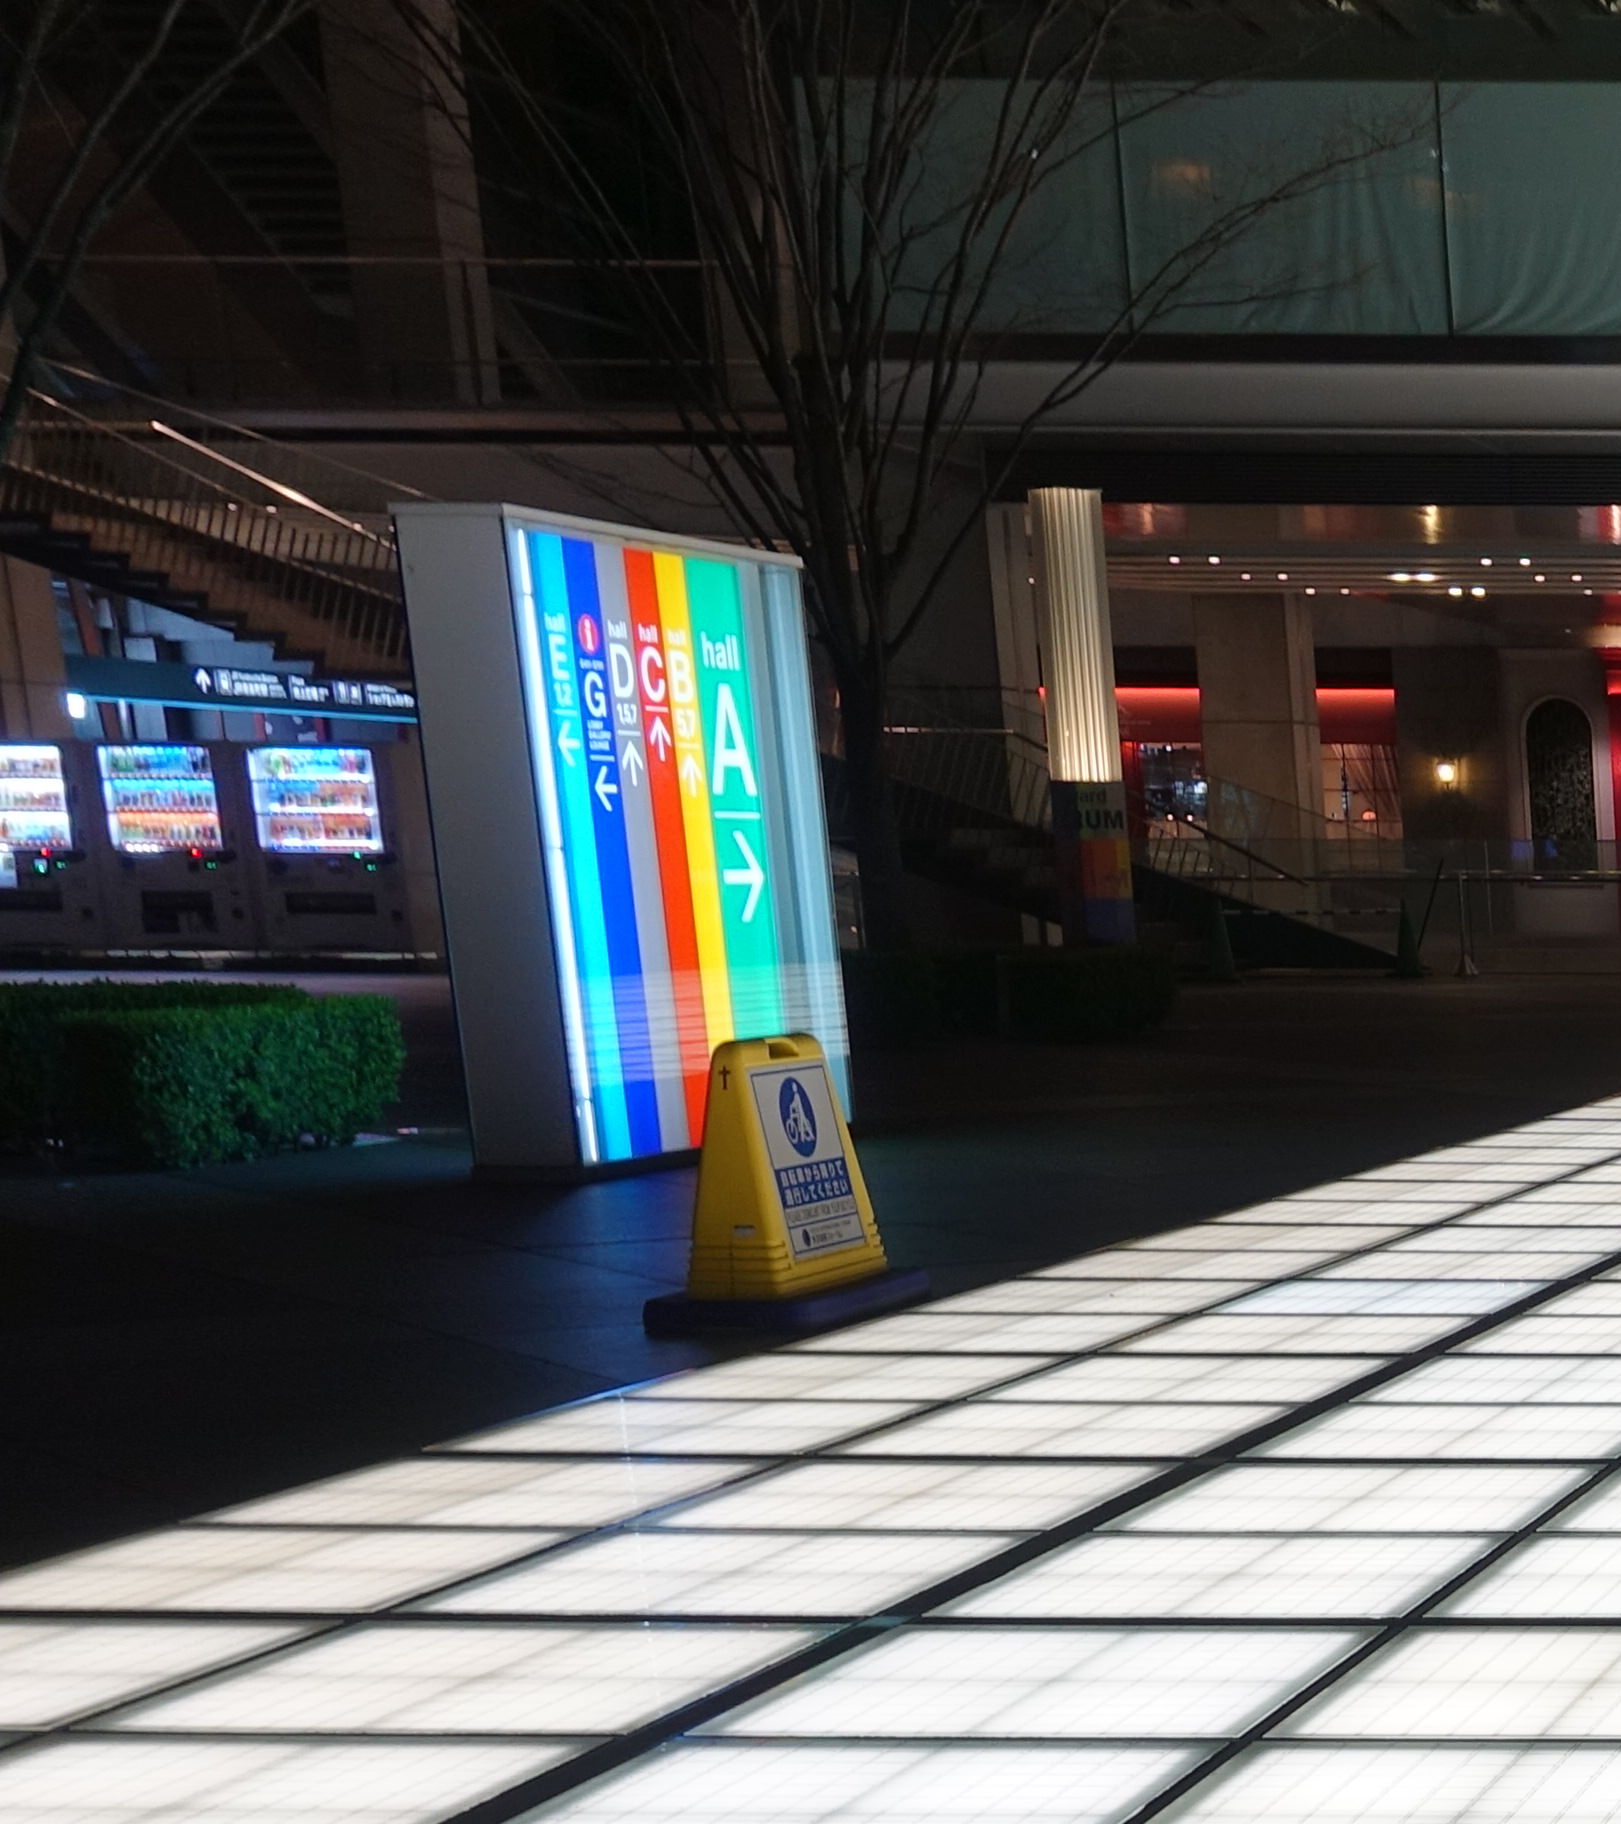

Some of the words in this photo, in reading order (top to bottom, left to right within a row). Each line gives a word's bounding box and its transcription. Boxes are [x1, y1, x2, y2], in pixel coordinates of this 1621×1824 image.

[544, 612, 566, 631] hall
[607, 621, 629, 640] hall
[638, 623, 659, 643] hall
[667, 629, 688, 647] hall
[548, 633, 570, 680] E
[609, 643, 635, 698] D
[640, 646, 666, 702] C
[701, 631, 740, 671] hall
[584, 671, 607, 718] G
[669, 650, 695, 703] B
[712, 682, 758, 796] A
